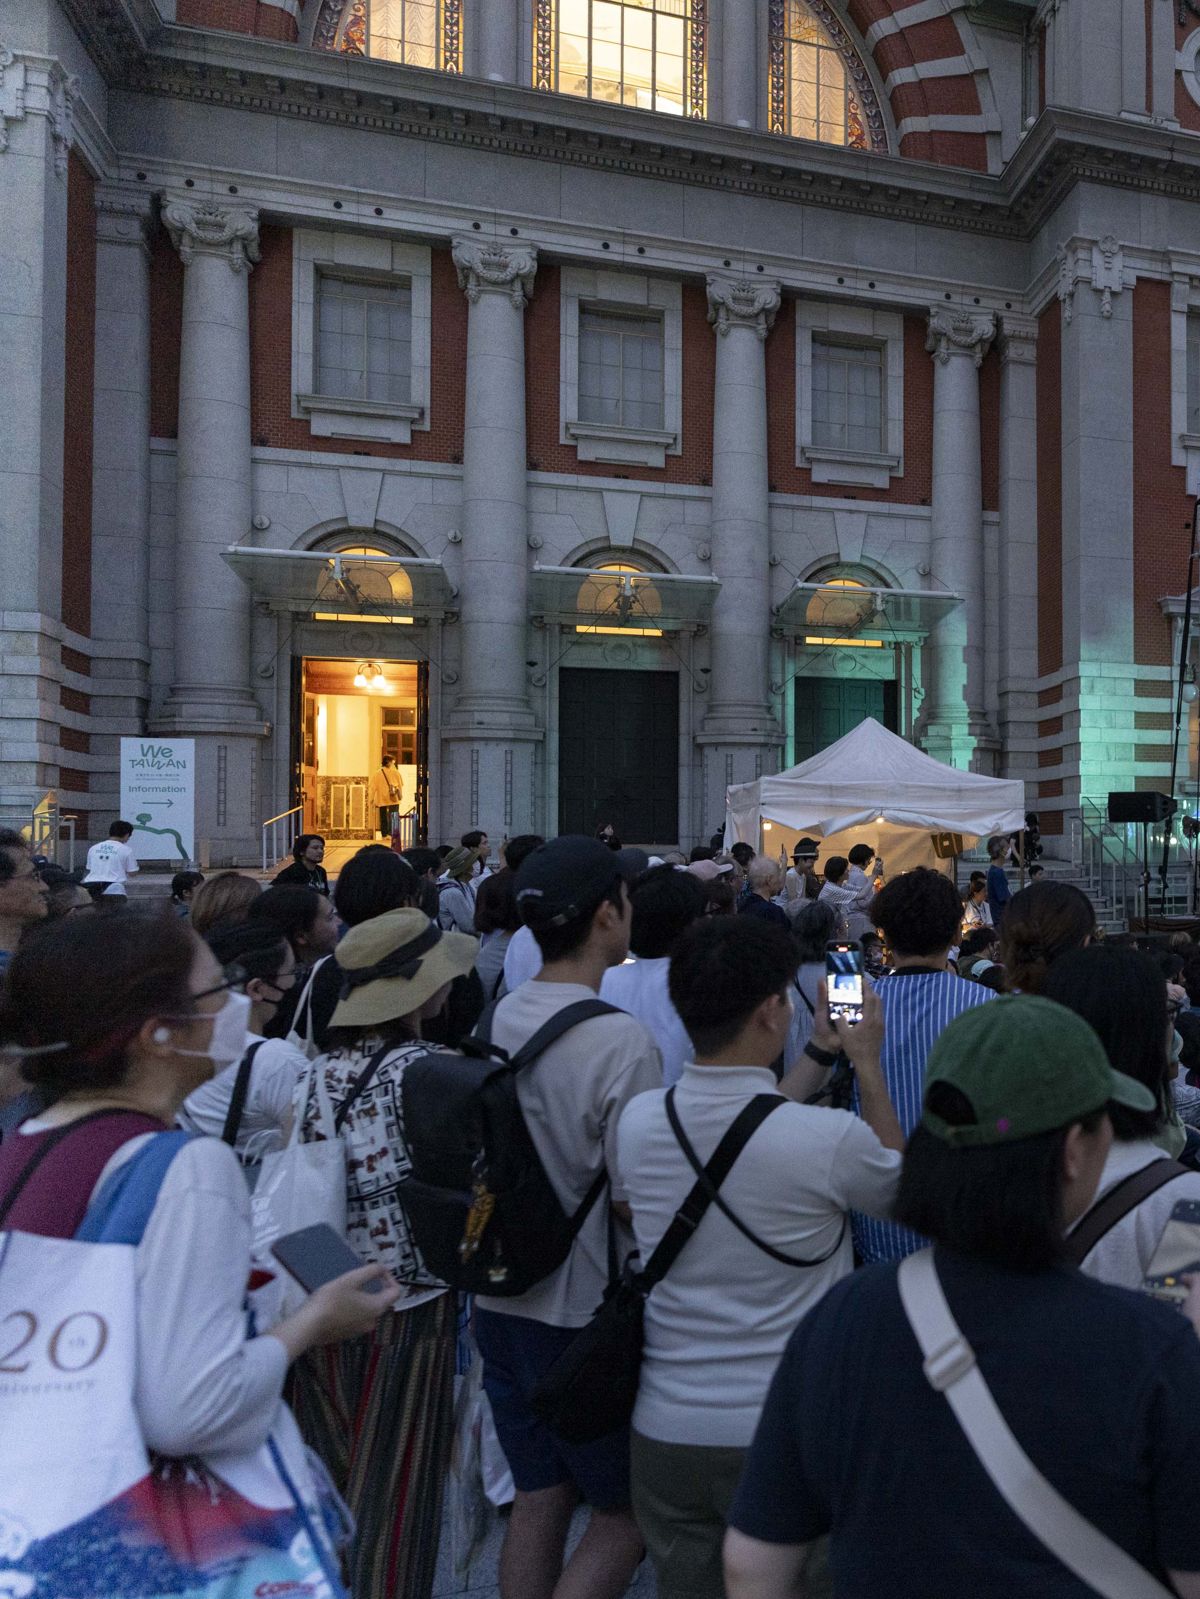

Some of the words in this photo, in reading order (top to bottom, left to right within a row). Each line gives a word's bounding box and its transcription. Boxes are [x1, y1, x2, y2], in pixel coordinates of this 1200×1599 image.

[140, 744, 173, 758] We
[128, 758, 187, 770] TAIWAN
[128, 785, 187, 793] Information
